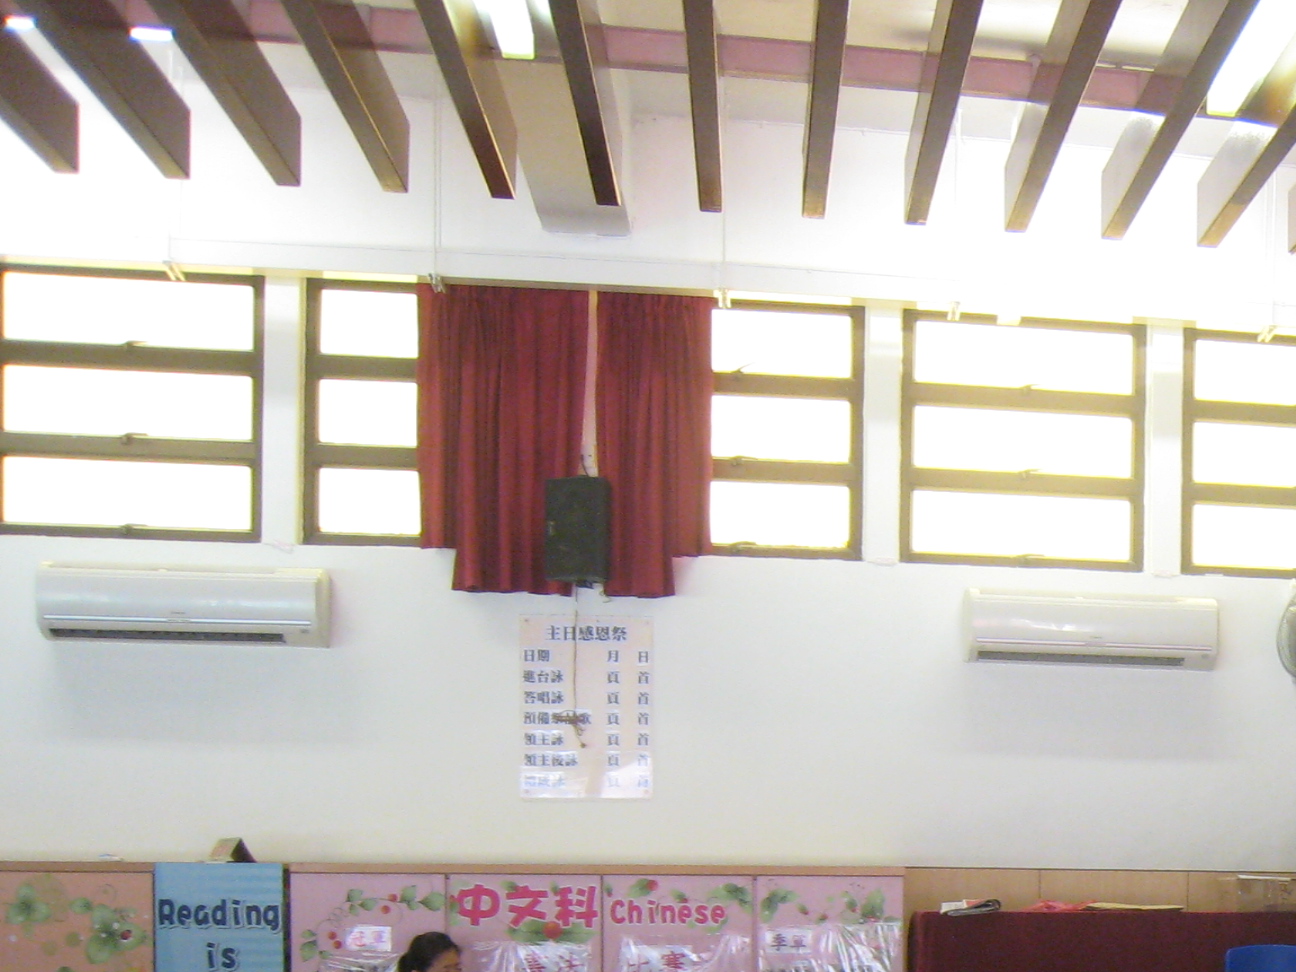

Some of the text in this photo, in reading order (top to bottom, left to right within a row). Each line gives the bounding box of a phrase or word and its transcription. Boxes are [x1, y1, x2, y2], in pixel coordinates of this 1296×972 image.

[547, 625, 627, 641] 主日感恩祭
[524, 649, 649, 663] 日期 月 日
[607, 671, 620, 684] 頁
[638, 672, 650, 684] 首
[607, 692, 620, 705] 頁
[638, 692, 650, 705] 首
[607, 712, 620, 726] 頁
[638, 712, 650, 725] 首
[607, 733, 620, 746] 頁
[638, 733, 650, 746] 首
[457, 884, 598, 928] 中文科
[610, 900, 726, 925] Chinese
[158, 898, 281, 931] Reading
[206, 942, 236, 969] is
